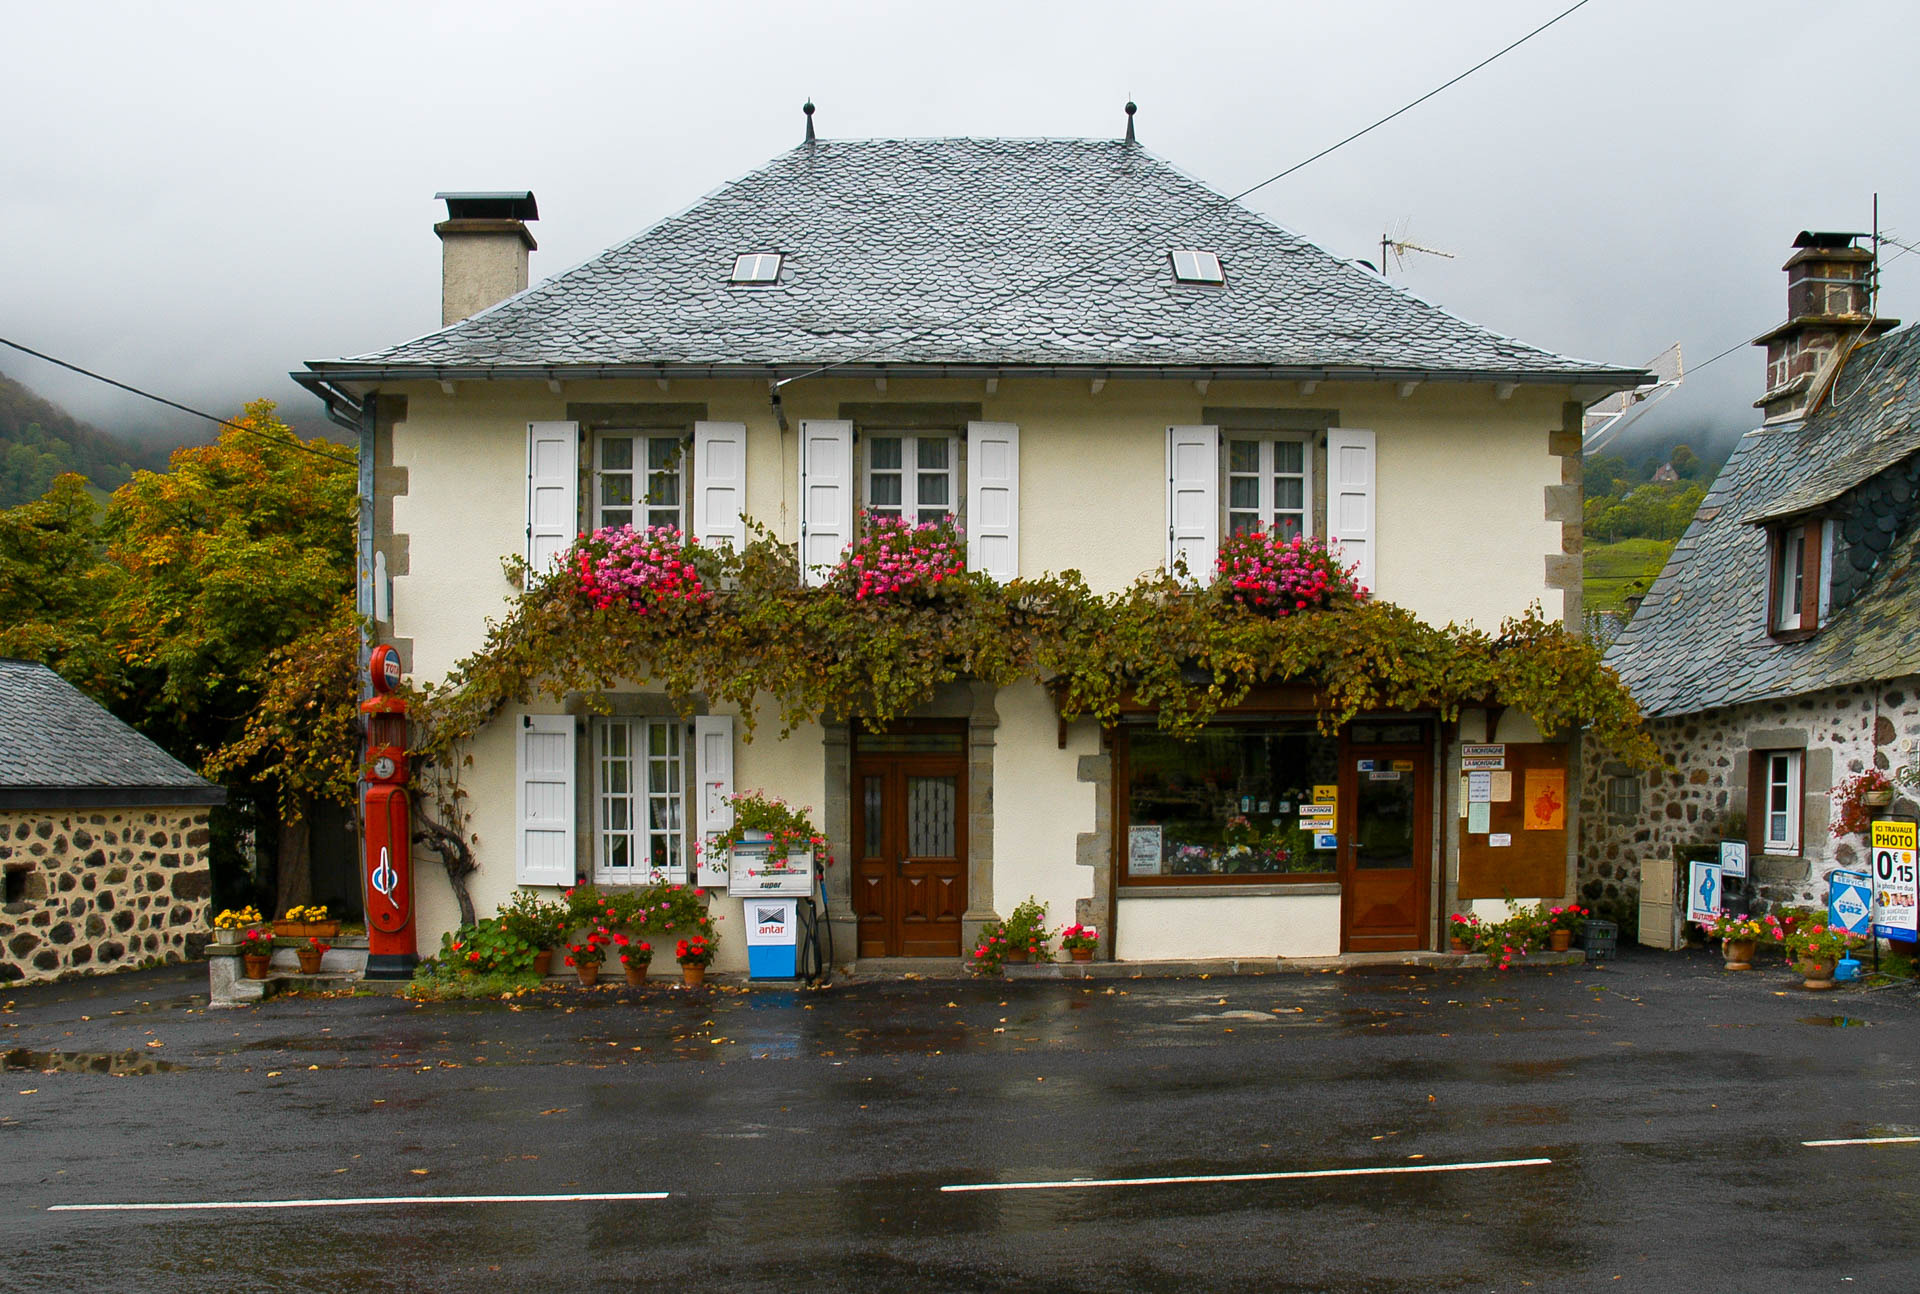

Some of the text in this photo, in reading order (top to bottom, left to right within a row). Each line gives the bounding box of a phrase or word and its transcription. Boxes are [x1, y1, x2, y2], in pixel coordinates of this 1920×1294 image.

[1464, 746, 1503, 755] LA MONTAGNE
[1885, 826, 1912, 834] TRAVAUX
[1875, 834, 1913, 847] PHOTO
[760, 881, 783, 889] super
[1838, 876, 1867, 887] SERVICE
[1882, 882, 1896, 890] photo
[1838, 903, 1862, 916] gaz
[758, 924, 785, 935] antar
